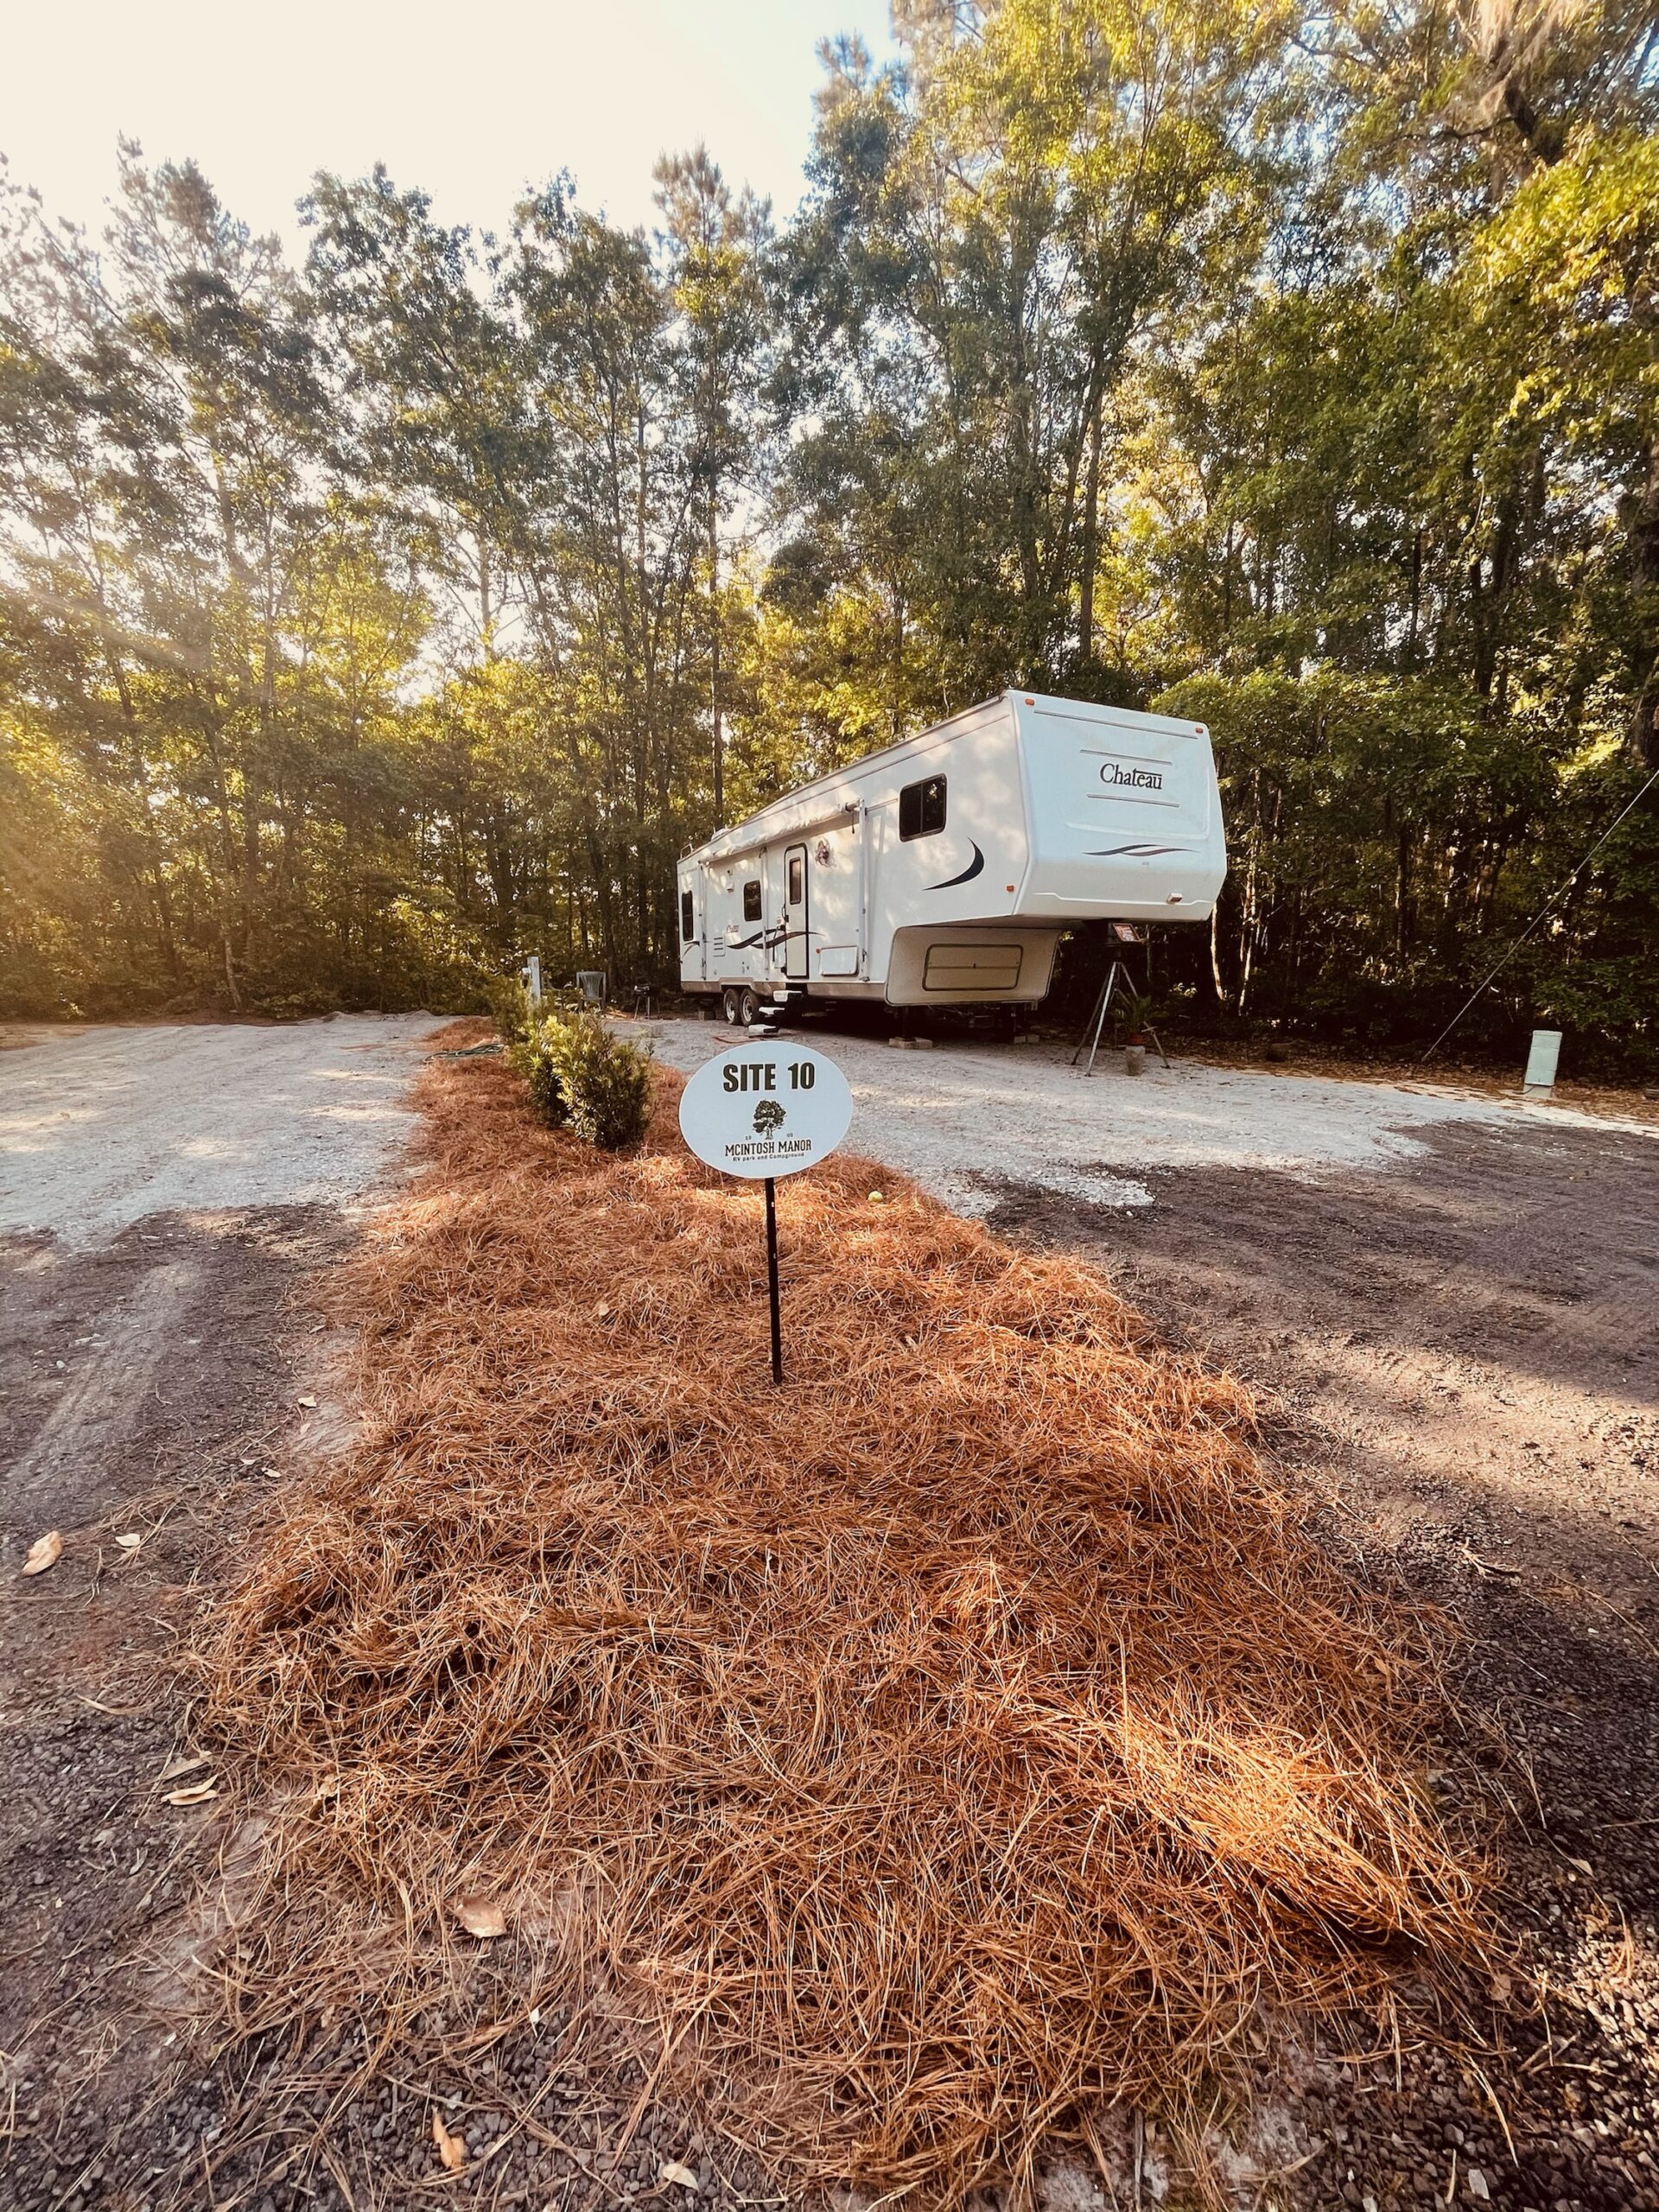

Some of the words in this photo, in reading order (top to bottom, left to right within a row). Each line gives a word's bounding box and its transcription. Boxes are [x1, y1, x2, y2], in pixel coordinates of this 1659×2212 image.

[1100, 763, 1162, 790] Chateau
[723, 1064, 776, 1092] SITE
[788, 1062, 815, 1090] 10
[725, 1141, 775, 1156] MCINTOSH
[779, 1140, 811, 1153] MANOR
